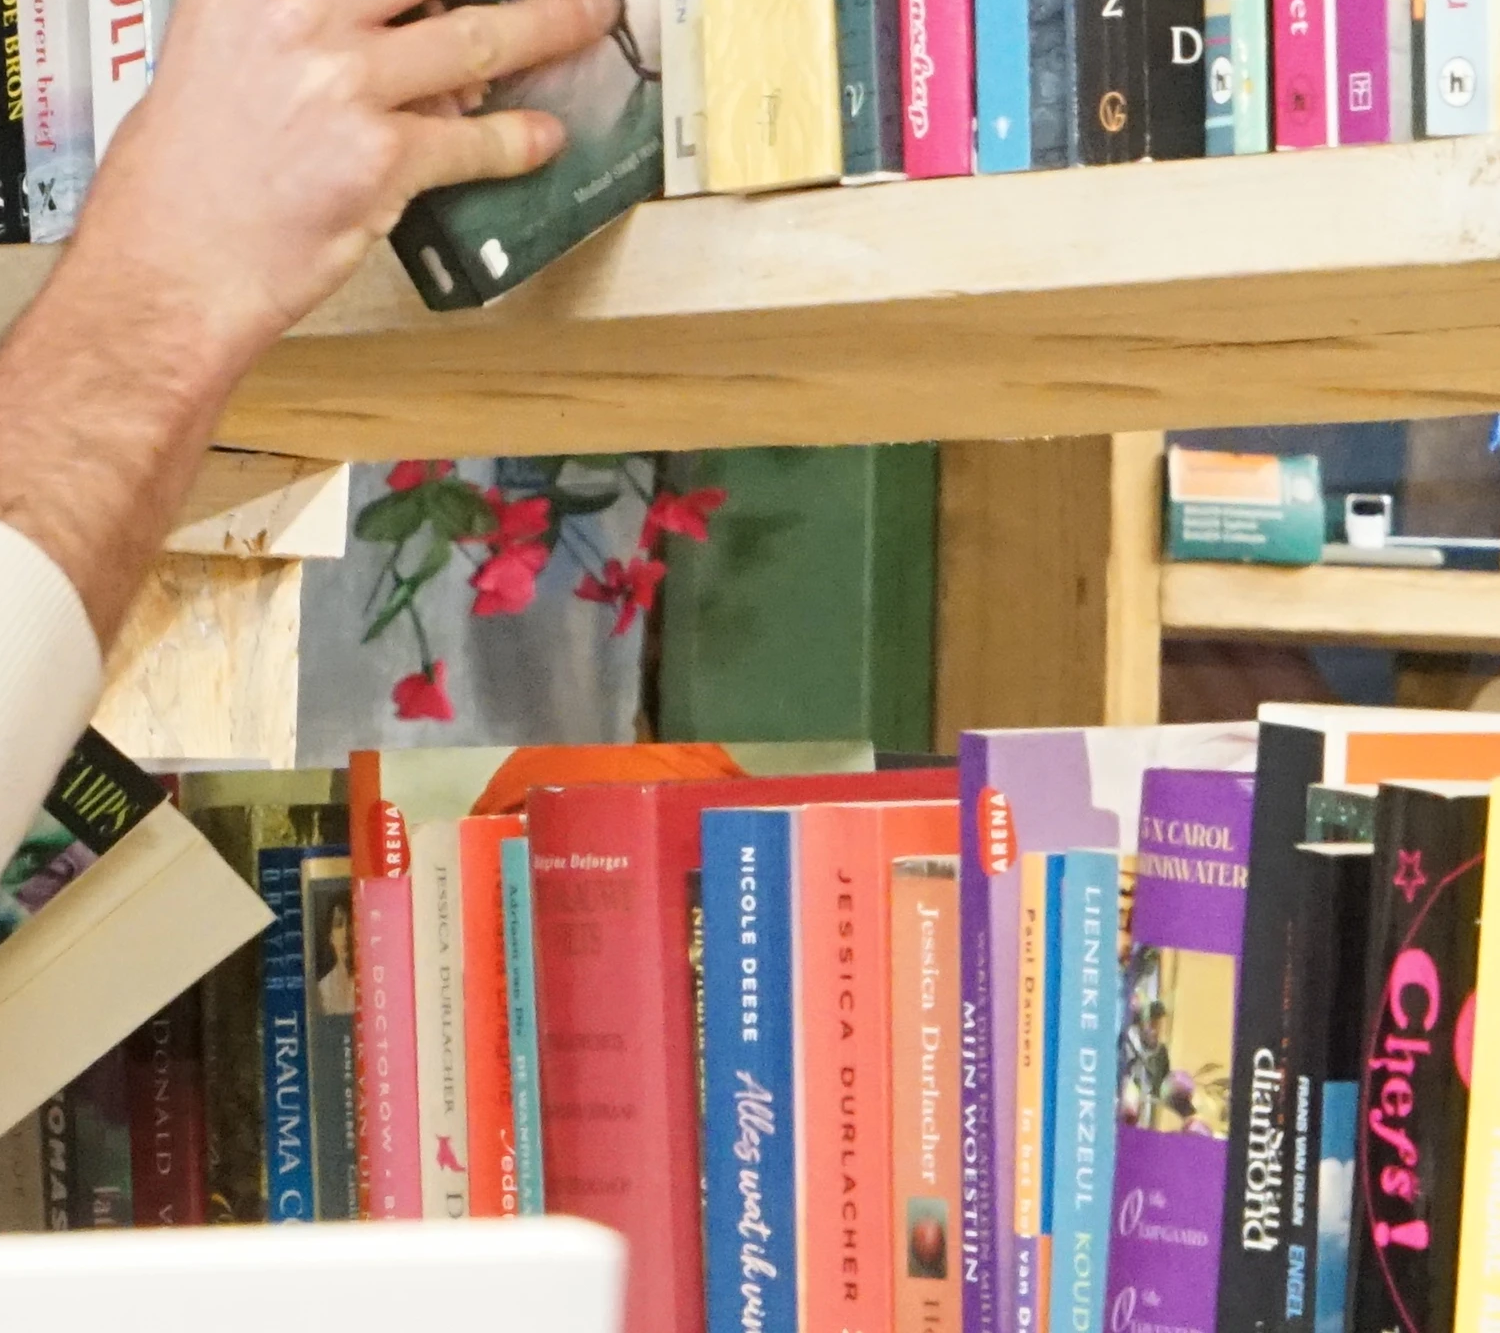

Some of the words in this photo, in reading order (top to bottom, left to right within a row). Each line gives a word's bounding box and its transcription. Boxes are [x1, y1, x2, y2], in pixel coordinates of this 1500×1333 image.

[4, 35, 24, 123] BRON
[33, 75, 56, 153] brief
[837, 870, 855, 1042] JESSICA
[917, 903, 940, 1009] Jessica
[1023, 909, 1035, 959] Paul
[1082, 888, 1101, 1030] LIENEKE
[275, 1012, 302, 1175] TRAUMA
[1021, 978, 1034, 1067] Damen
[921, 1026, 942, 1185] Durlacher
[1076, 1048, 1097, 1210] DIJKZEUL
[840, 1067, 859, 1303] DURLACHER
